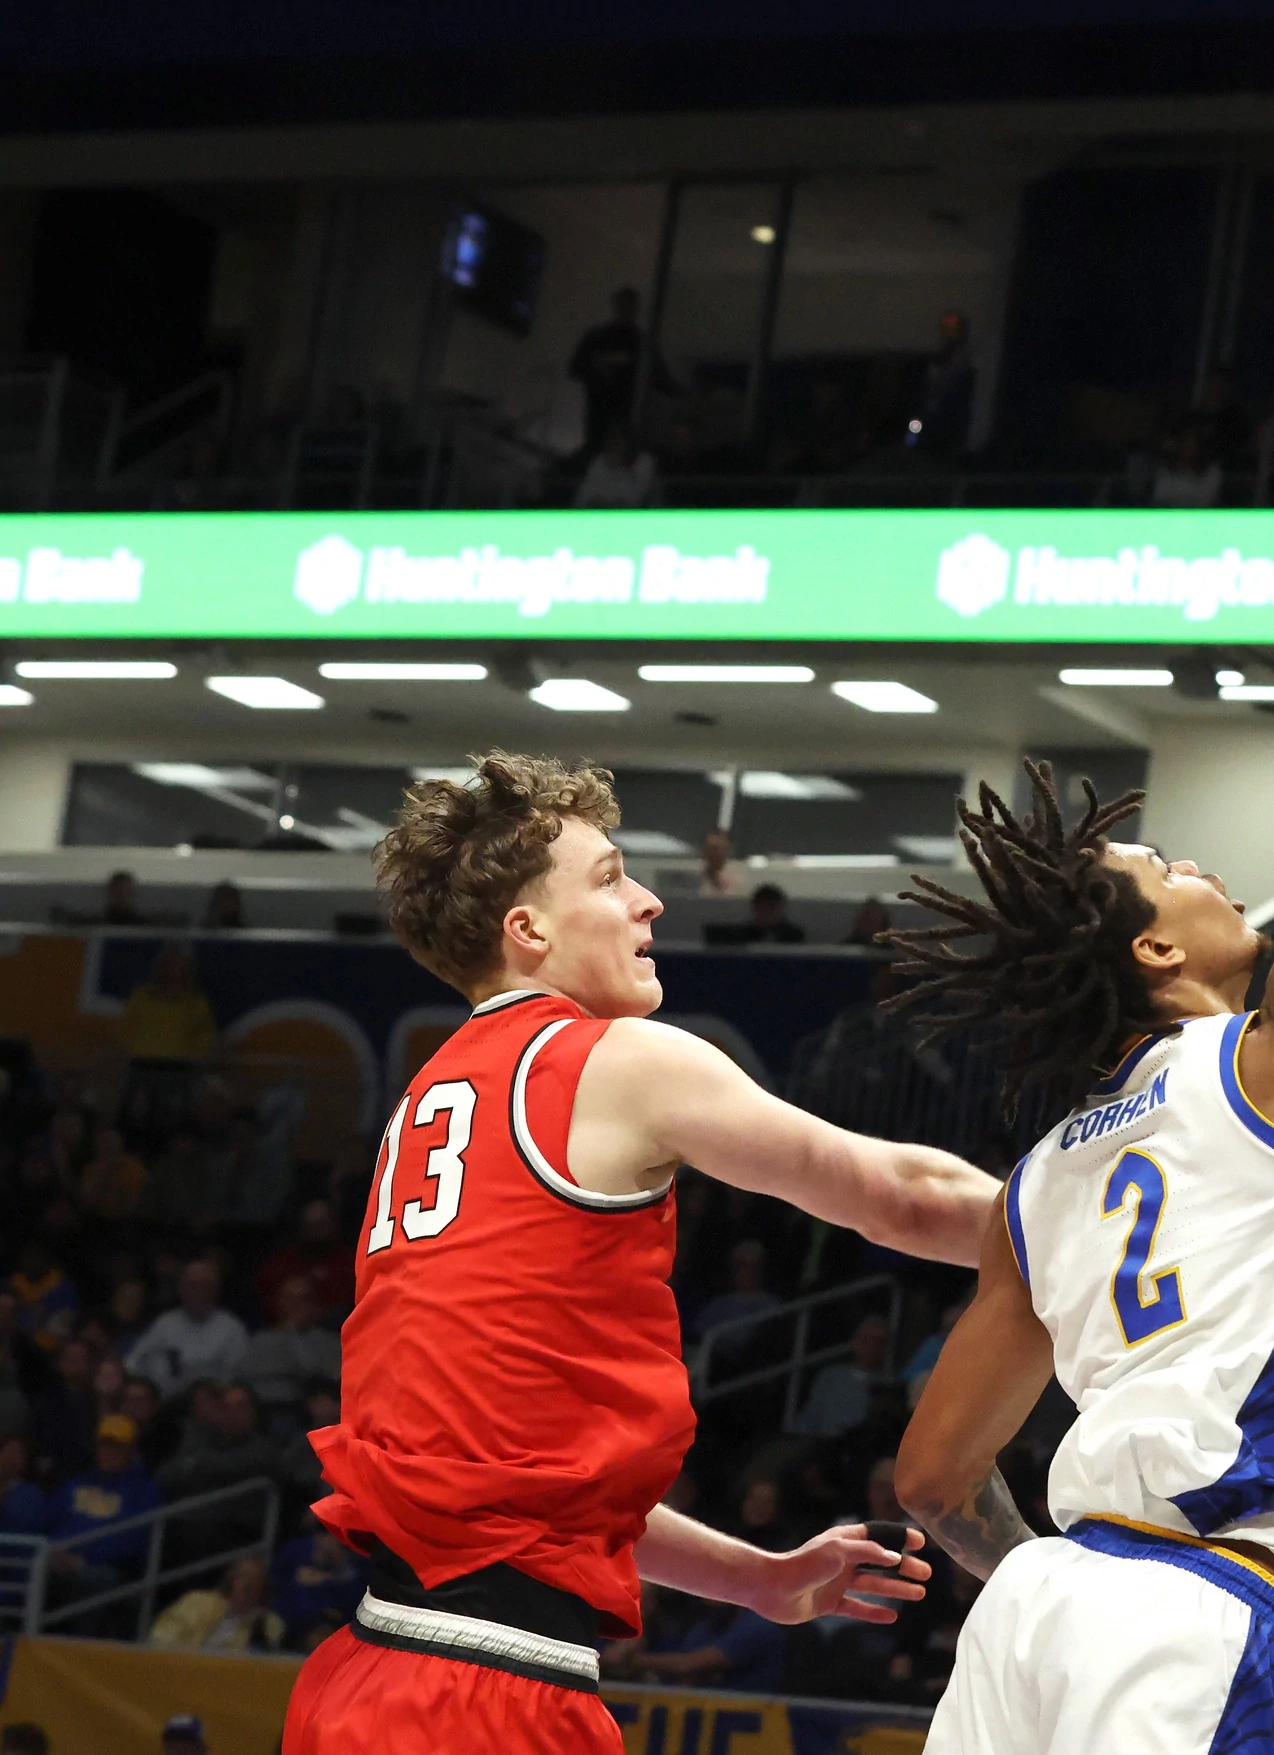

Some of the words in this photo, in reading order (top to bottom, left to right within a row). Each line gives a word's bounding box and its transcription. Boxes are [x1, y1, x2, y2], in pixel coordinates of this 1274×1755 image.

[24, 546, 143, 602] Bank
[364, 544, 634, 616] Huntington
[638, 545, 770, 602] Bank
[366, 1078, 479, 1258] 13
[1100, 1147, 1188, 1351] 2
